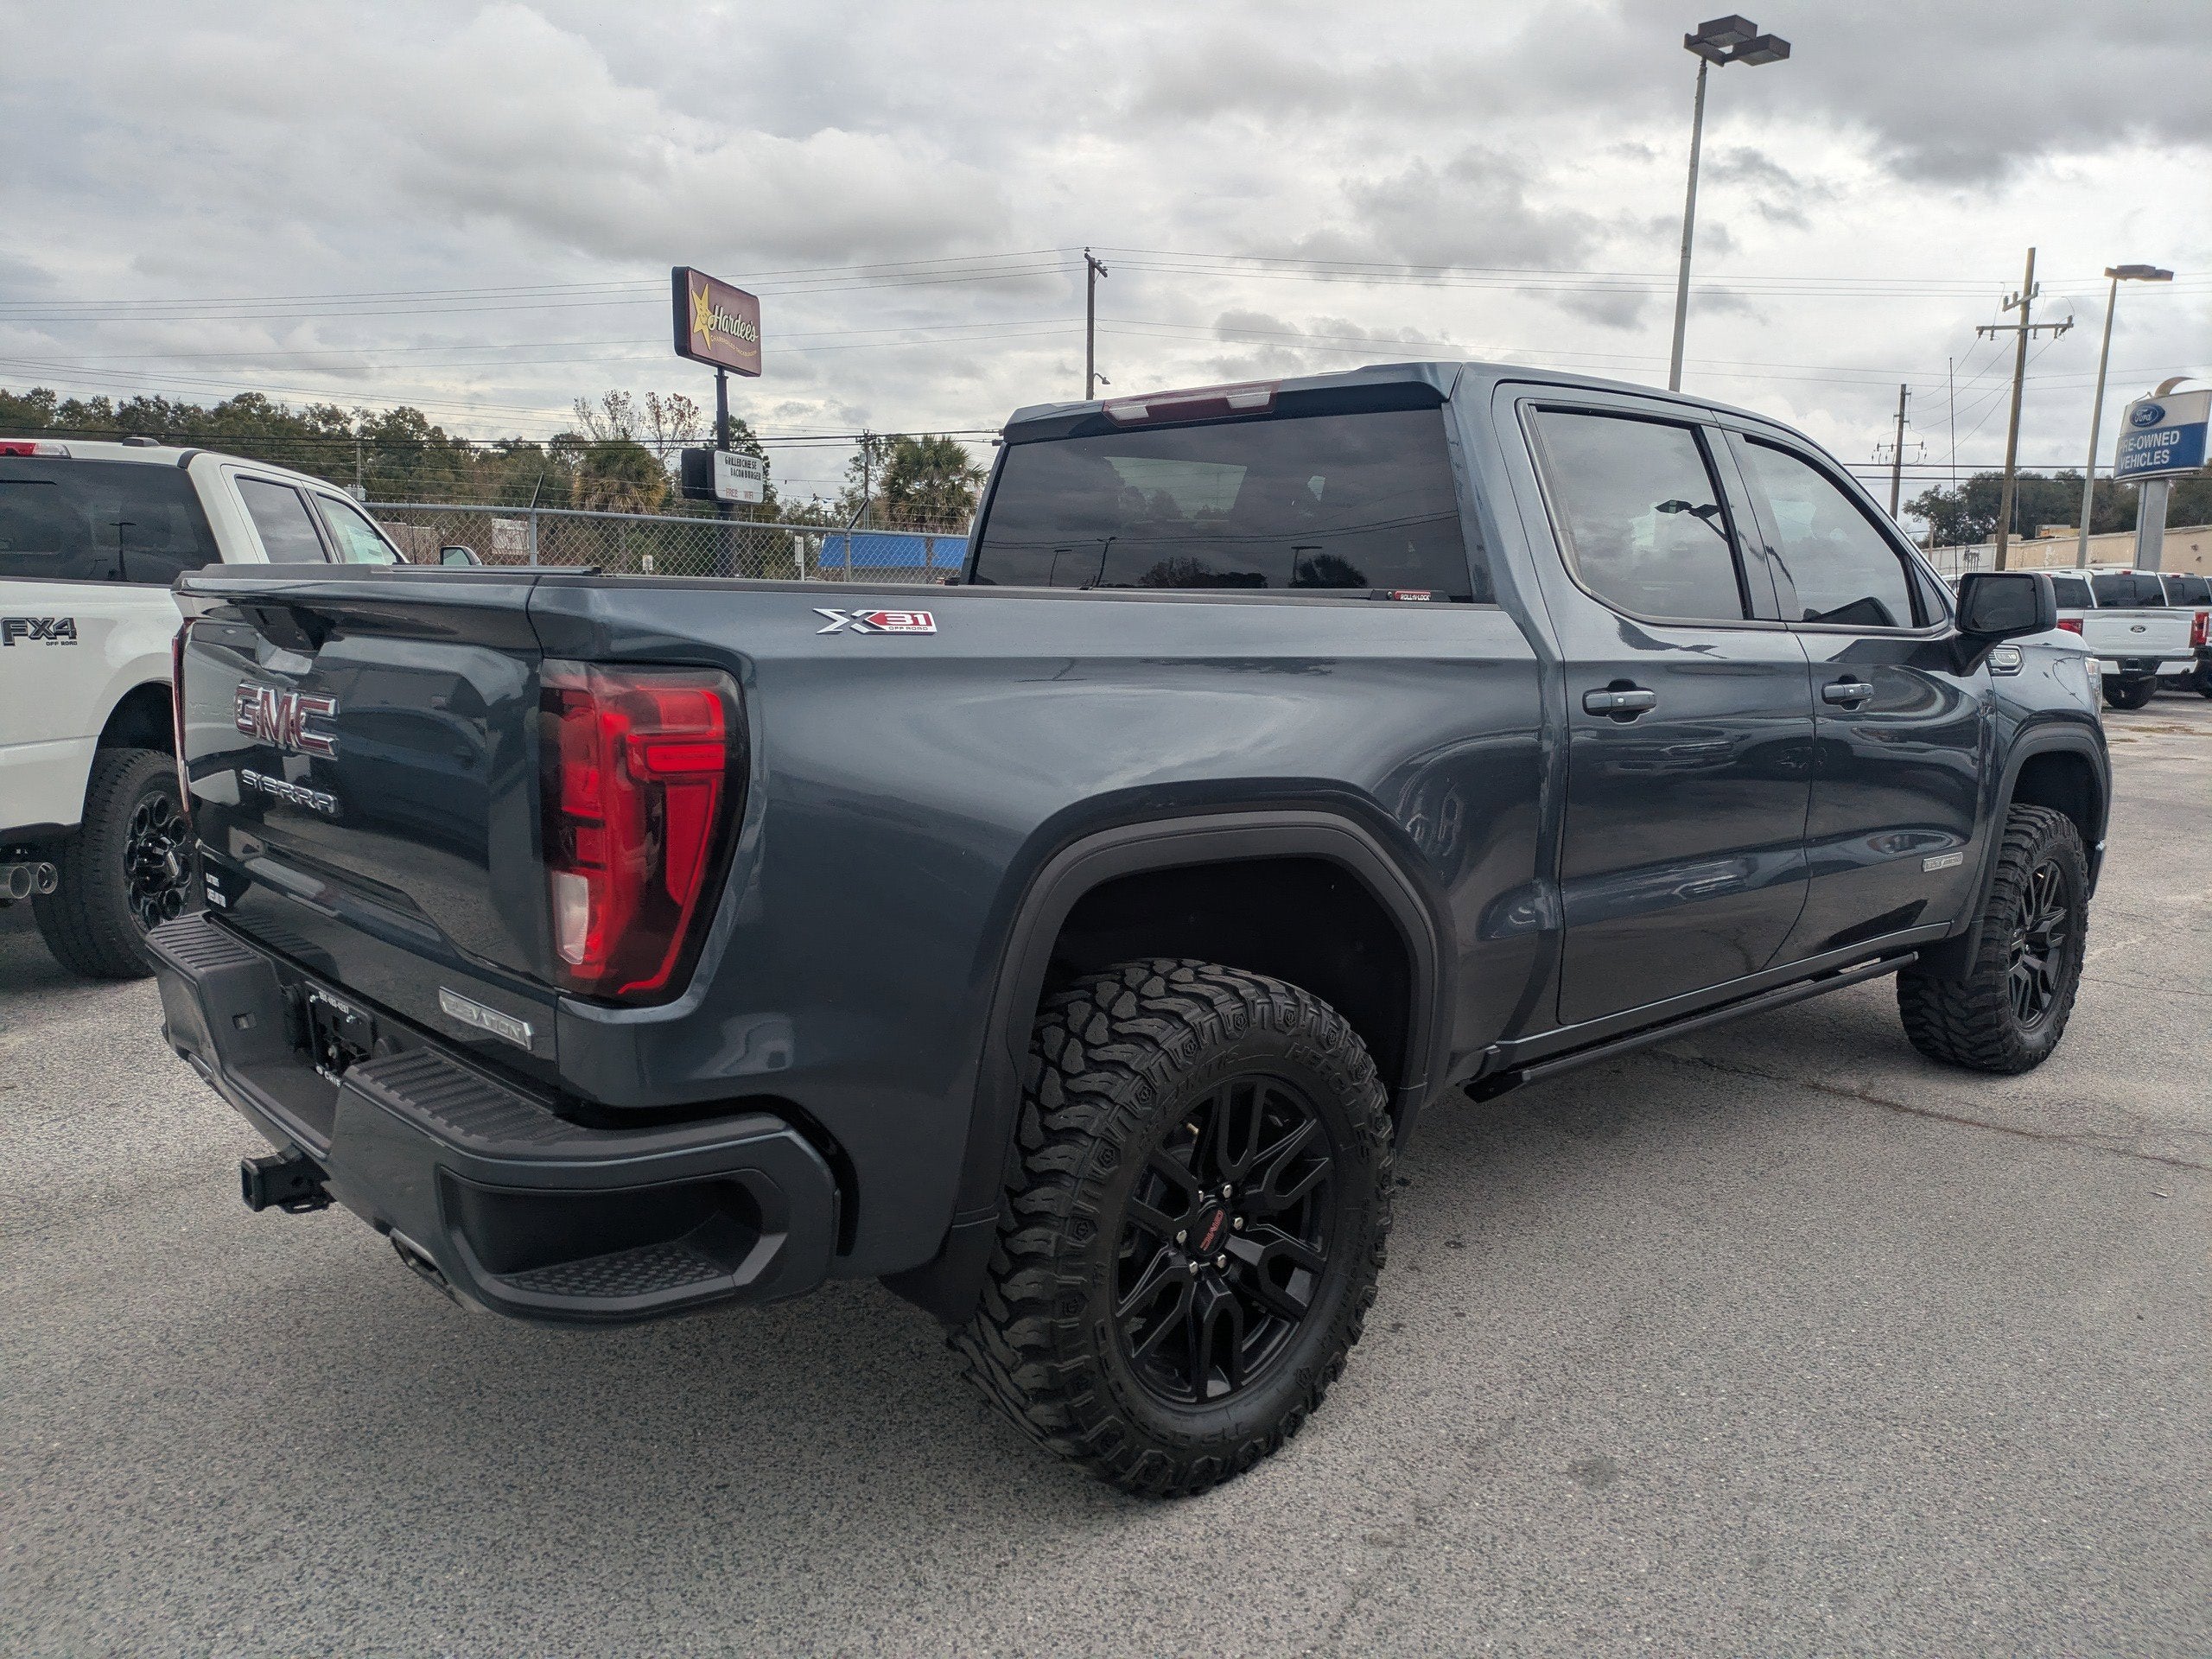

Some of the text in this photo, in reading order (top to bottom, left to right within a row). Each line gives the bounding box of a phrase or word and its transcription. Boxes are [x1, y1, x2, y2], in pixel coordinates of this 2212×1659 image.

[708, 304, 759, 342] Hardee's
[2134, 409, 2152, 423] Ford
[2120, 448, 2170, 470] VEHICLES
[1, 618, 78, 646] FX4
[234, 679, 340, 761] GMC
[241, 768, 339, 816] SIERRA
[1199, 1209, 1224, 1251] GMC
